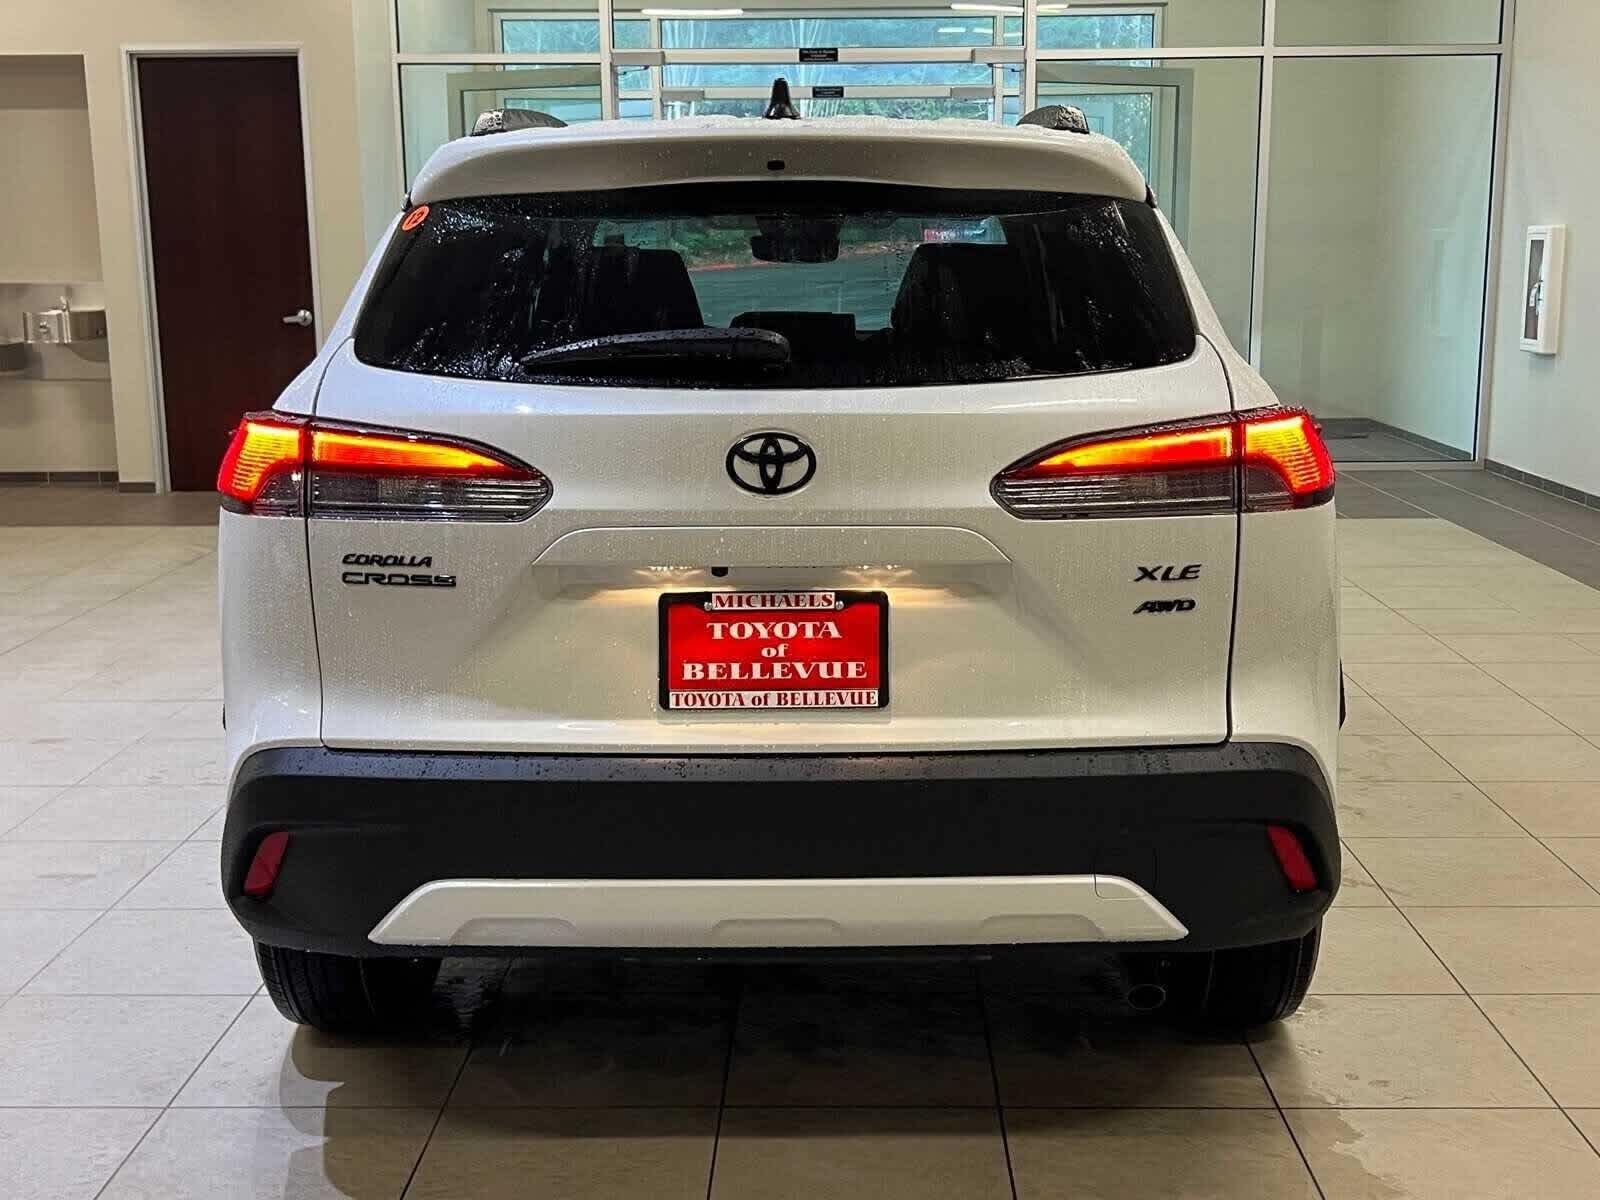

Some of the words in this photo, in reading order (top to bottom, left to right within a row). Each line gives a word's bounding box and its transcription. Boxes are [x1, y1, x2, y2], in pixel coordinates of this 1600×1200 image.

[342, 553, 432, 568] COROLLA
[342, 572, 456, 587] CROSS
[1133, 564, 1202, 582] XLE
[714, 594, 833, 608] MICHAELS
[1132, 599, 1196, 615] AWD
[706, 621, 842, 640] TOYOTA
[761, 643, 789, 658] of
[682, 661, 867, 681] BELLEVUE
[671, 692, 745, 707] TOYOTA
[751, 692, 769, 707] of
[776, 690, 877, 707] BELLEVUE
